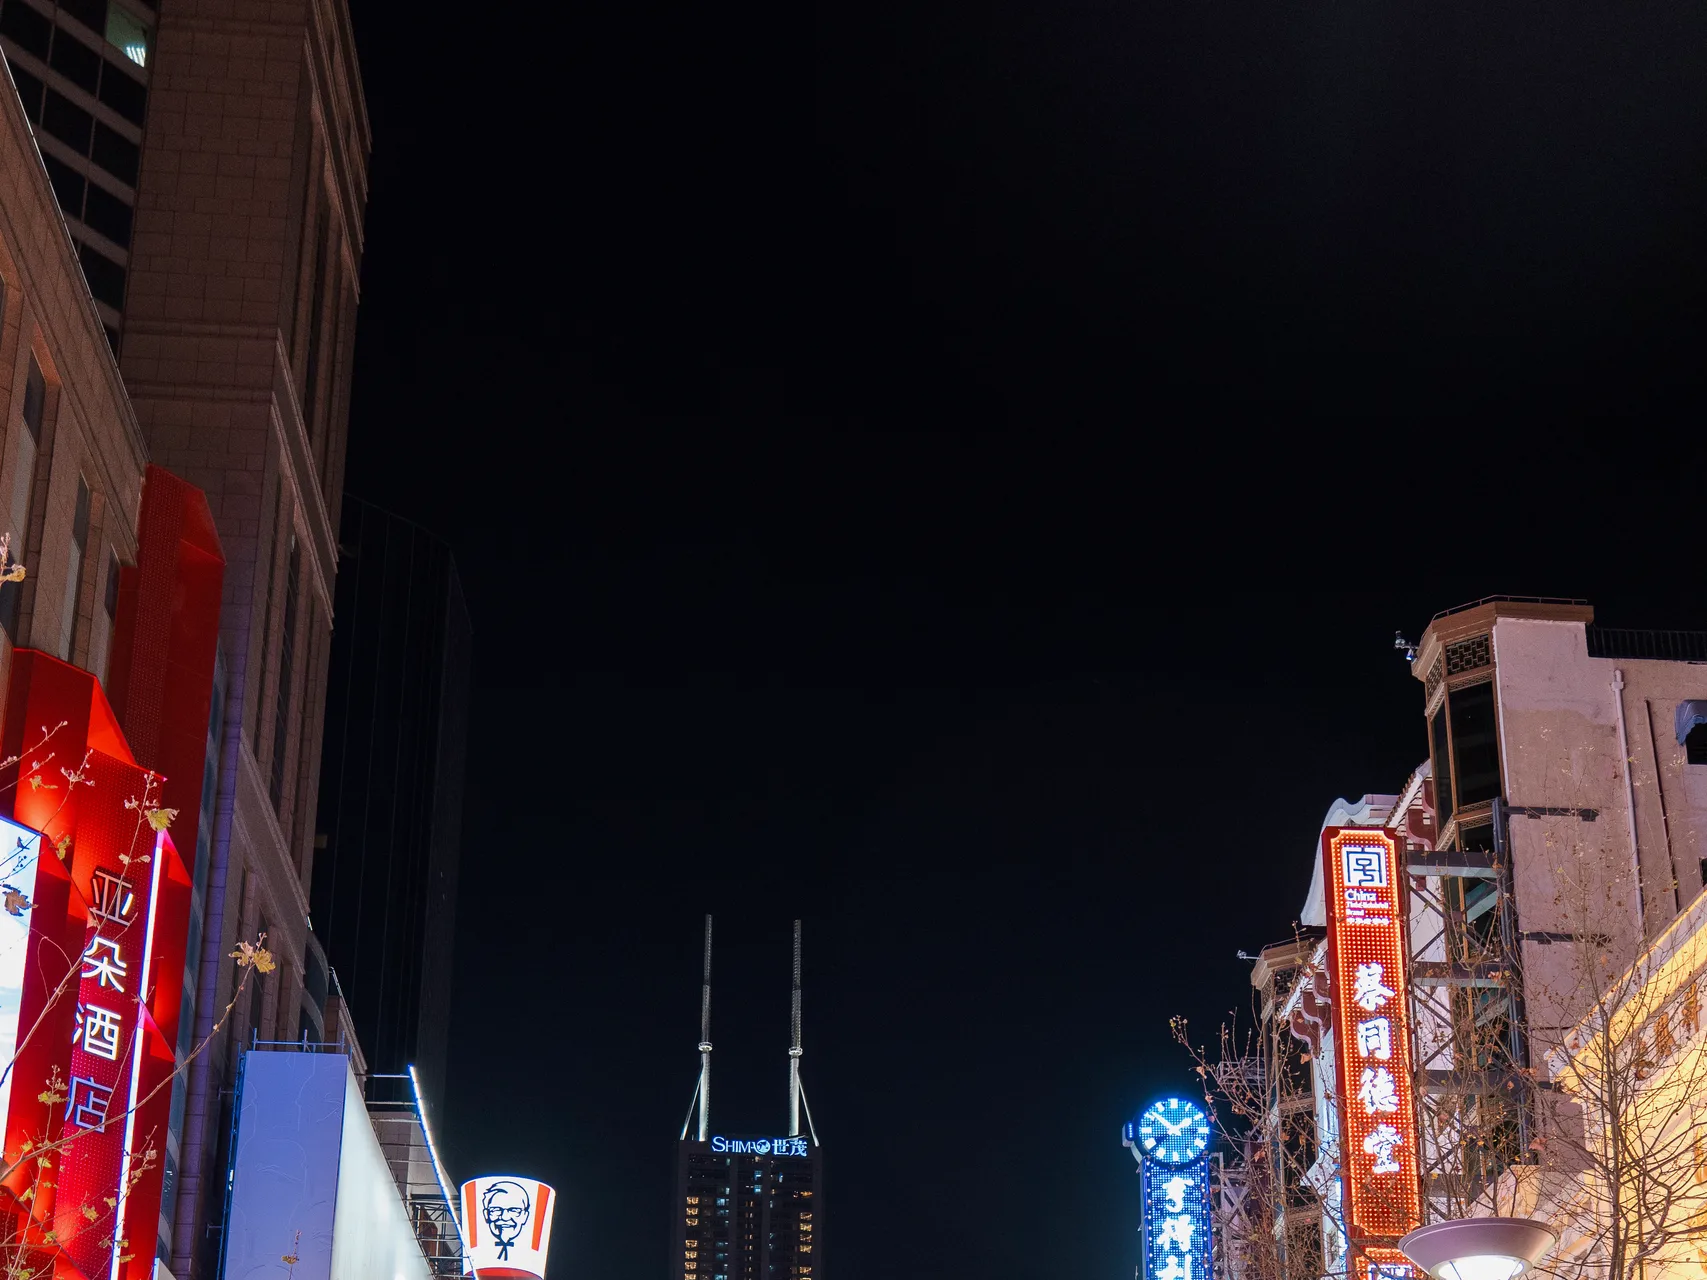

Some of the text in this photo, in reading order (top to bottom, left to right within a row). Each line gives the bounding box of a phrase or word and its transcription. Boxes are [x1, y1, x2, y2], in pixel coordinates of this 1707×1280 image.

[64, 869, 133, 1134] 亚朵酒店
[772, 1138, 808, 1156] 世茂
